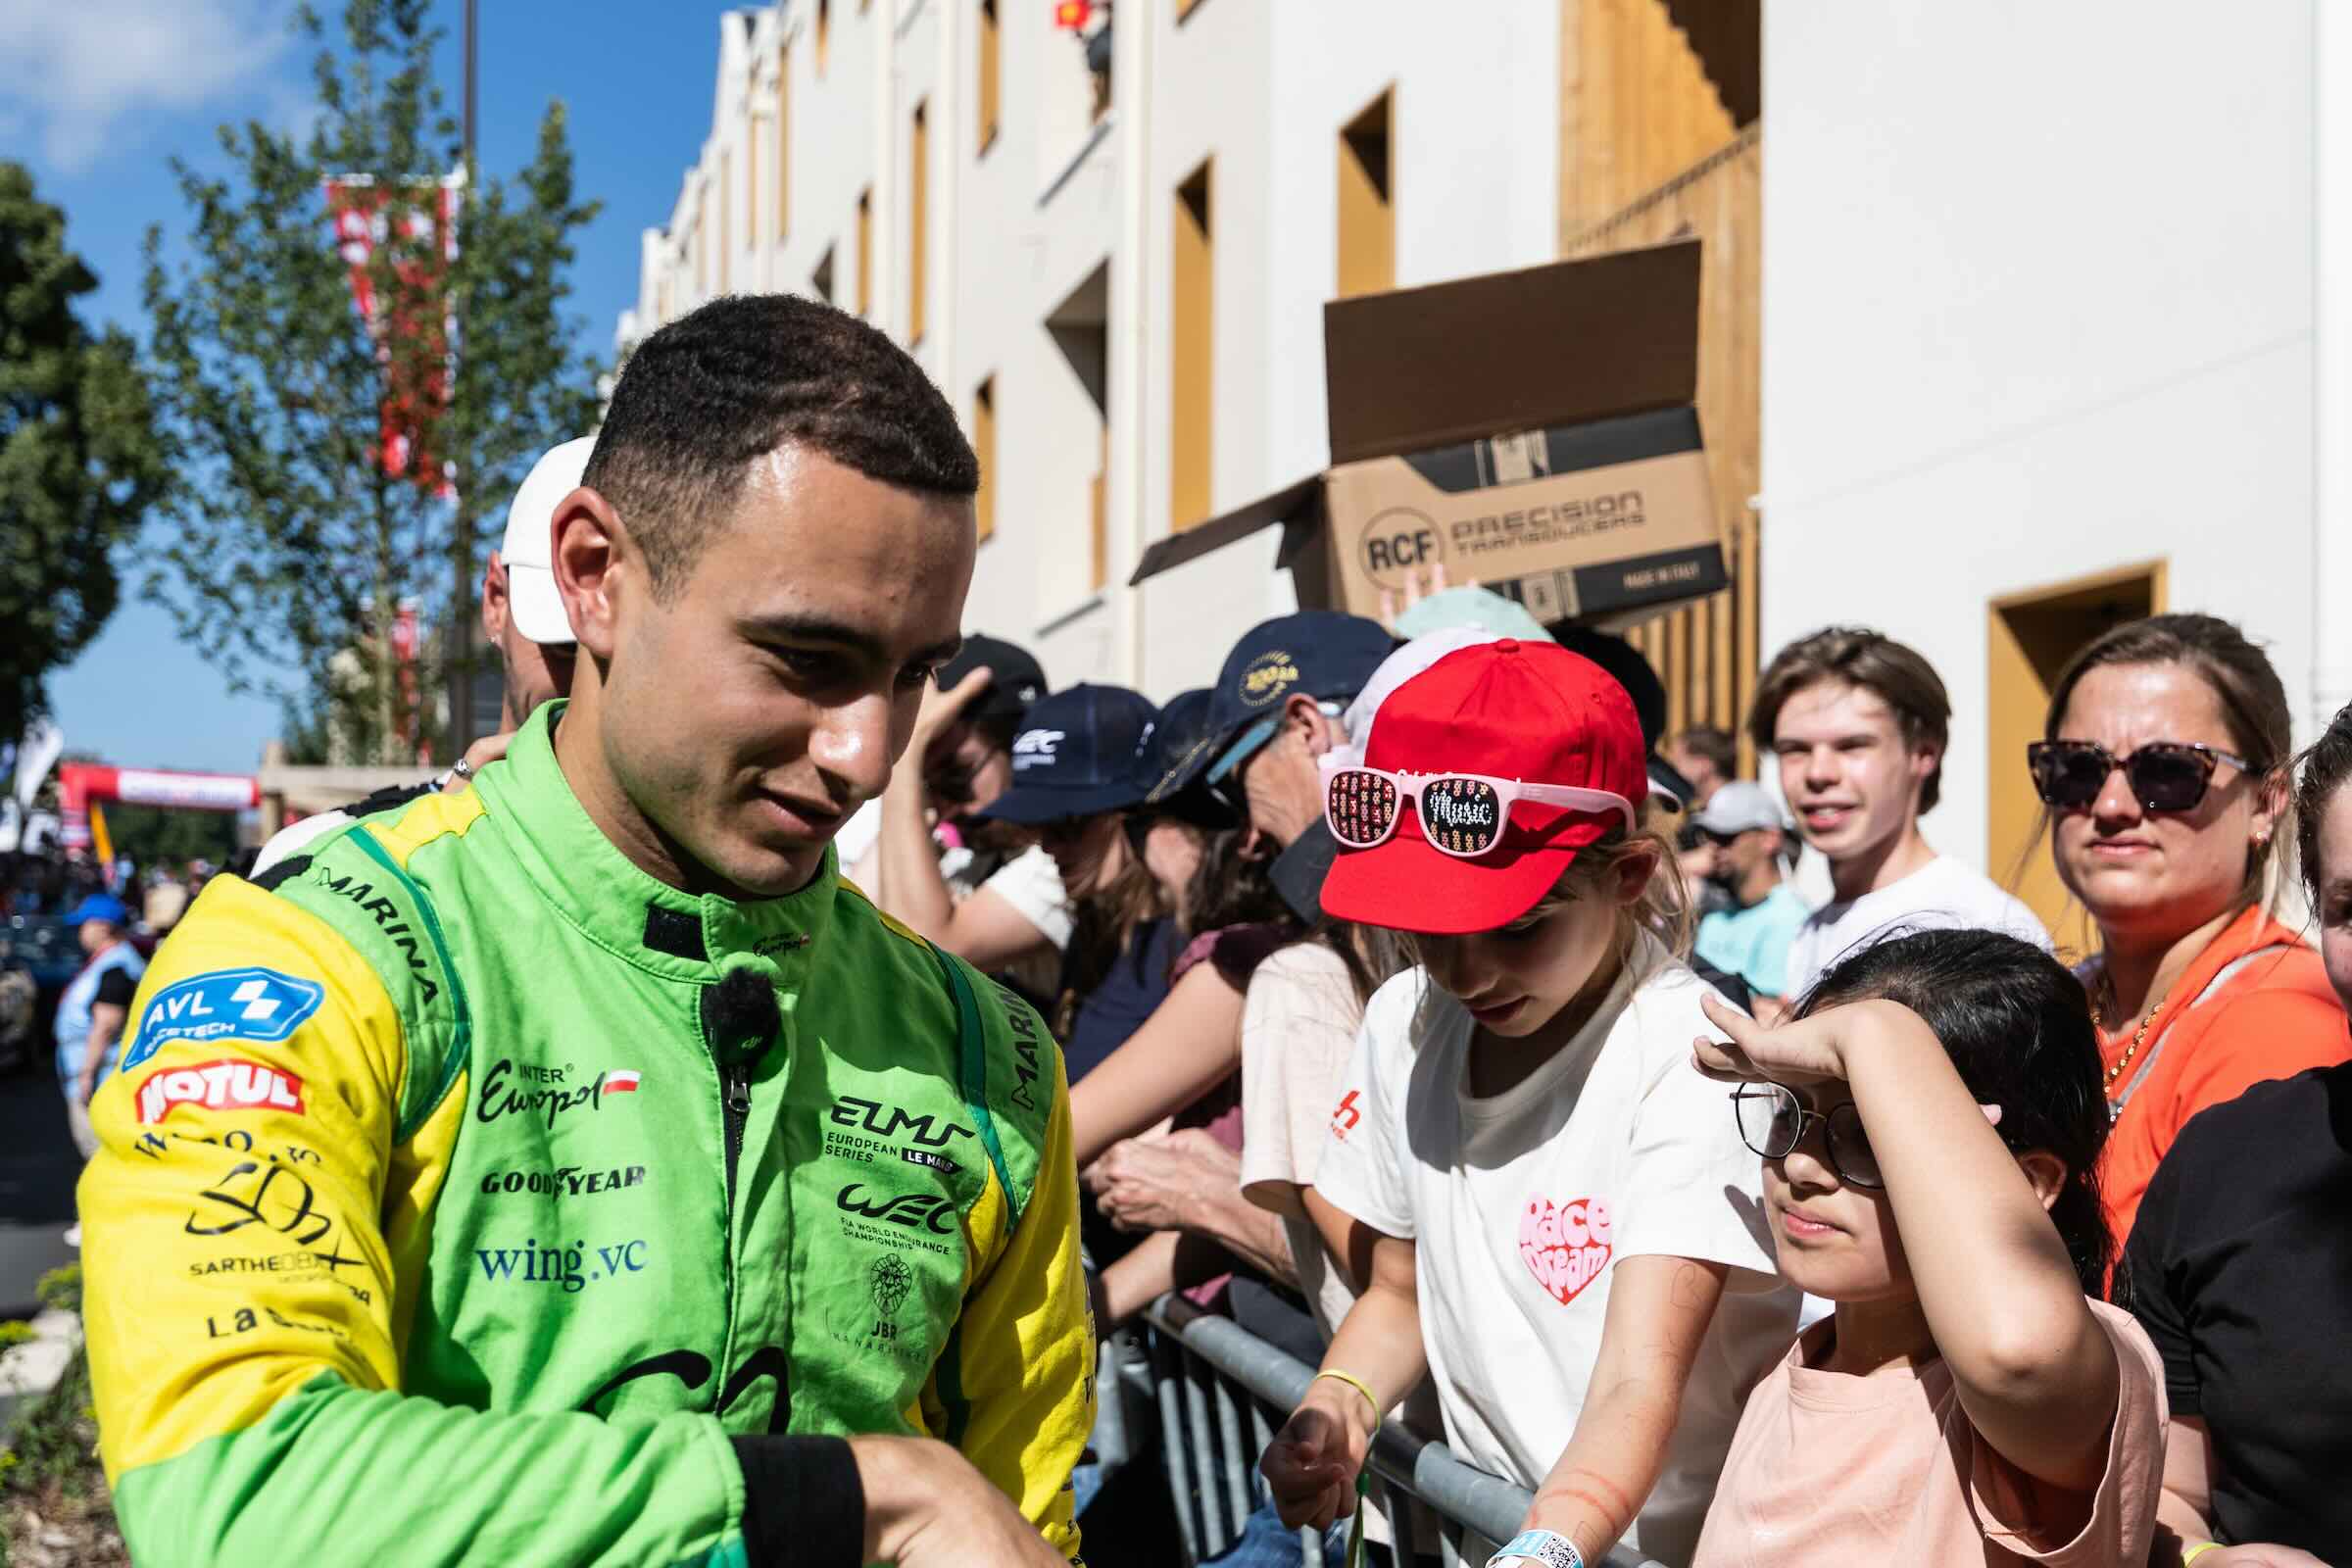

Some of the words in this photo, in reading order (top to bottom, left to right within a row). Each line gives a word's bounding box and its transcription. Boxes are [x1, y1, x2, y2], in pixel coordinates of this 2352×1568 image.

[1450, 490, 1644, 539] PRECISION
[1367, 529, 1433, 571] RCF
[1430, 792, 1493, 827] Music
[313, 866, 439, 1007] MARINA
[145, 990, 214, 1033] AVL
[141, 1063, 300, 1126] MOTUL
[477, 1058, 606, 1130] Europol
[519, 1064, 565, 1084] INTER
[830, 1096, 976, 1147] ELMS
[825, 1145, 874, 1163] SERIES
[907, 1151, 923, 1163] LE
[826, 1132, 898, 1156] EUROPEAN
[480, 1165, 646, 1196] GOODYEAR
[837, 1183, 956, 1235] WEC
[841, 1216, 855, 1228] FIA
[857, 1222, 891, 1237] WORLD
[843, 1227, 913, 1250] CHAMPIONSHIP
[475, 1239, 650, 1294] wing.vc
[870, 1320, 898, 1342] JBR
